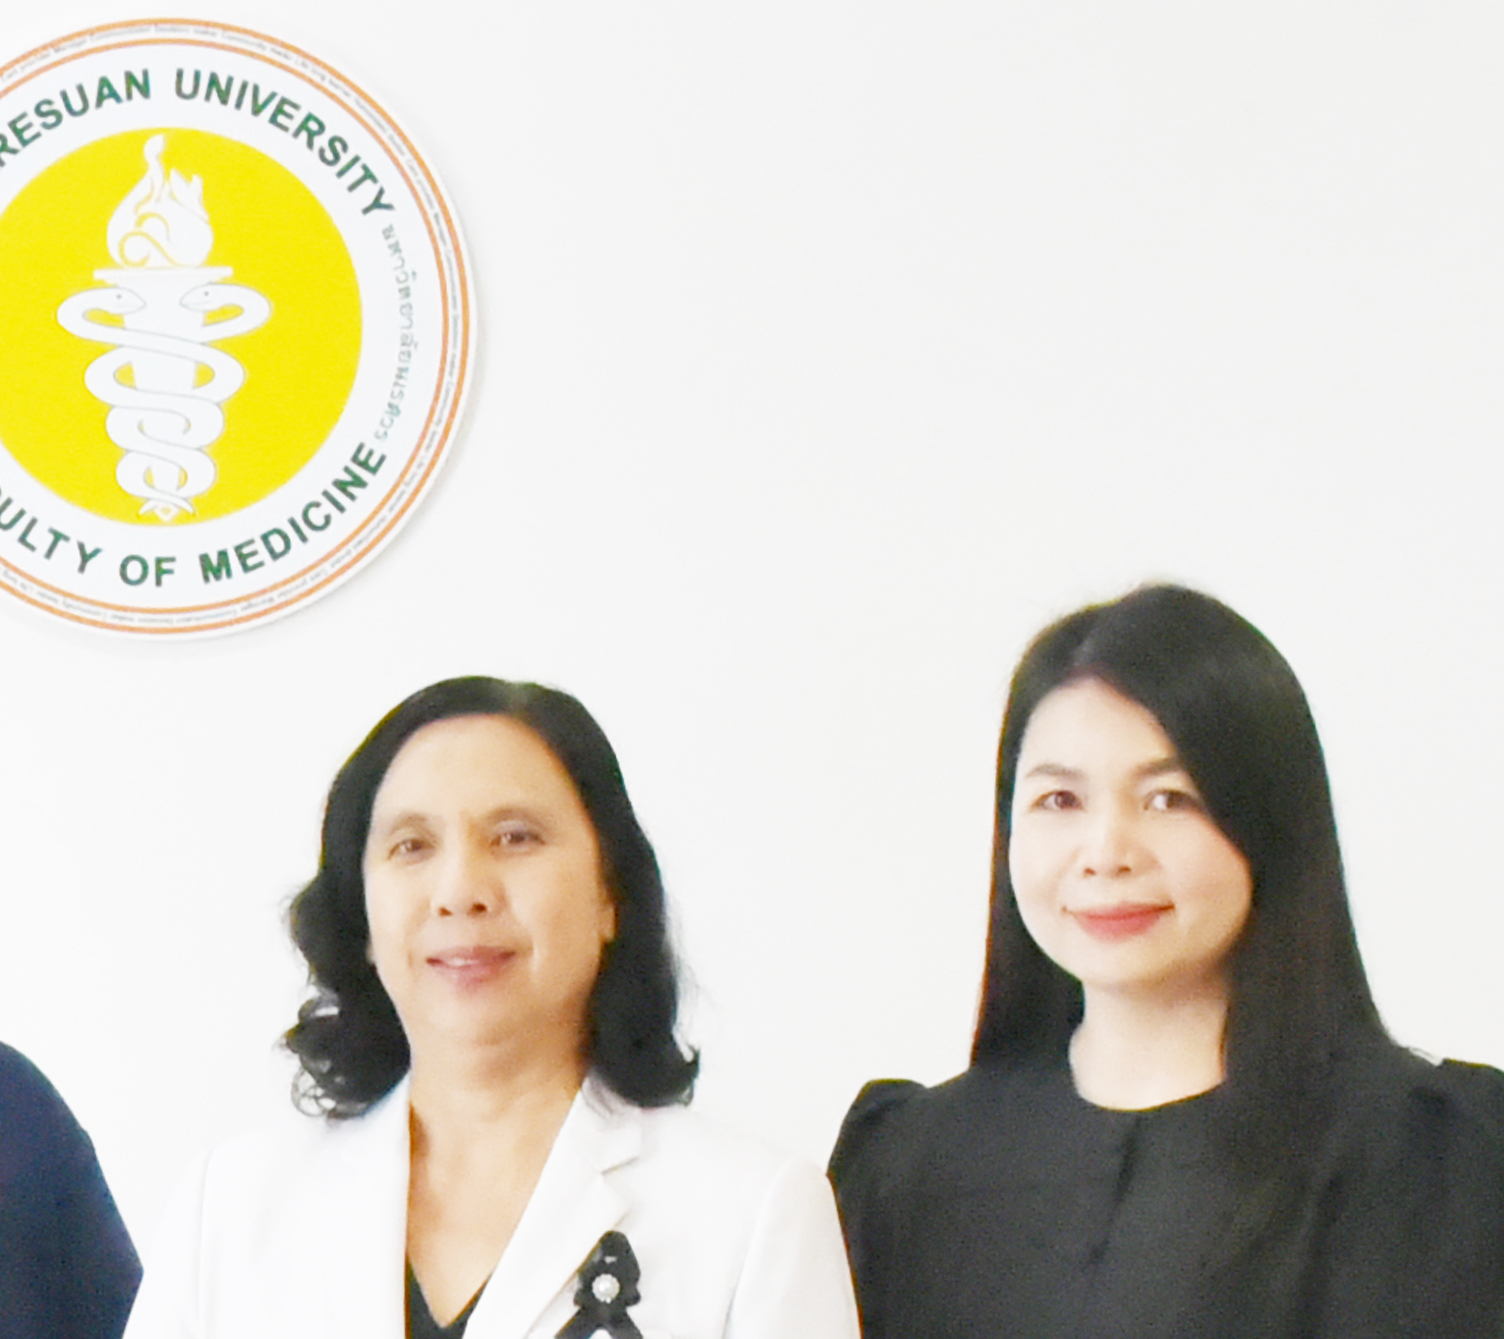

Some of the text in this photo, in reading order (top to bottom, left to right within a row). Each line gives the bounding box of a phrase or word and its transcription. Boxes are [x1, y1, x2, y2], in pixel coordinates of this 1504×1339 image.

[174, 67, 394, 217] UNIVERSITY
[120, 555, 177, 587] OF
[199, 442, 387, 585] MEDICINE
